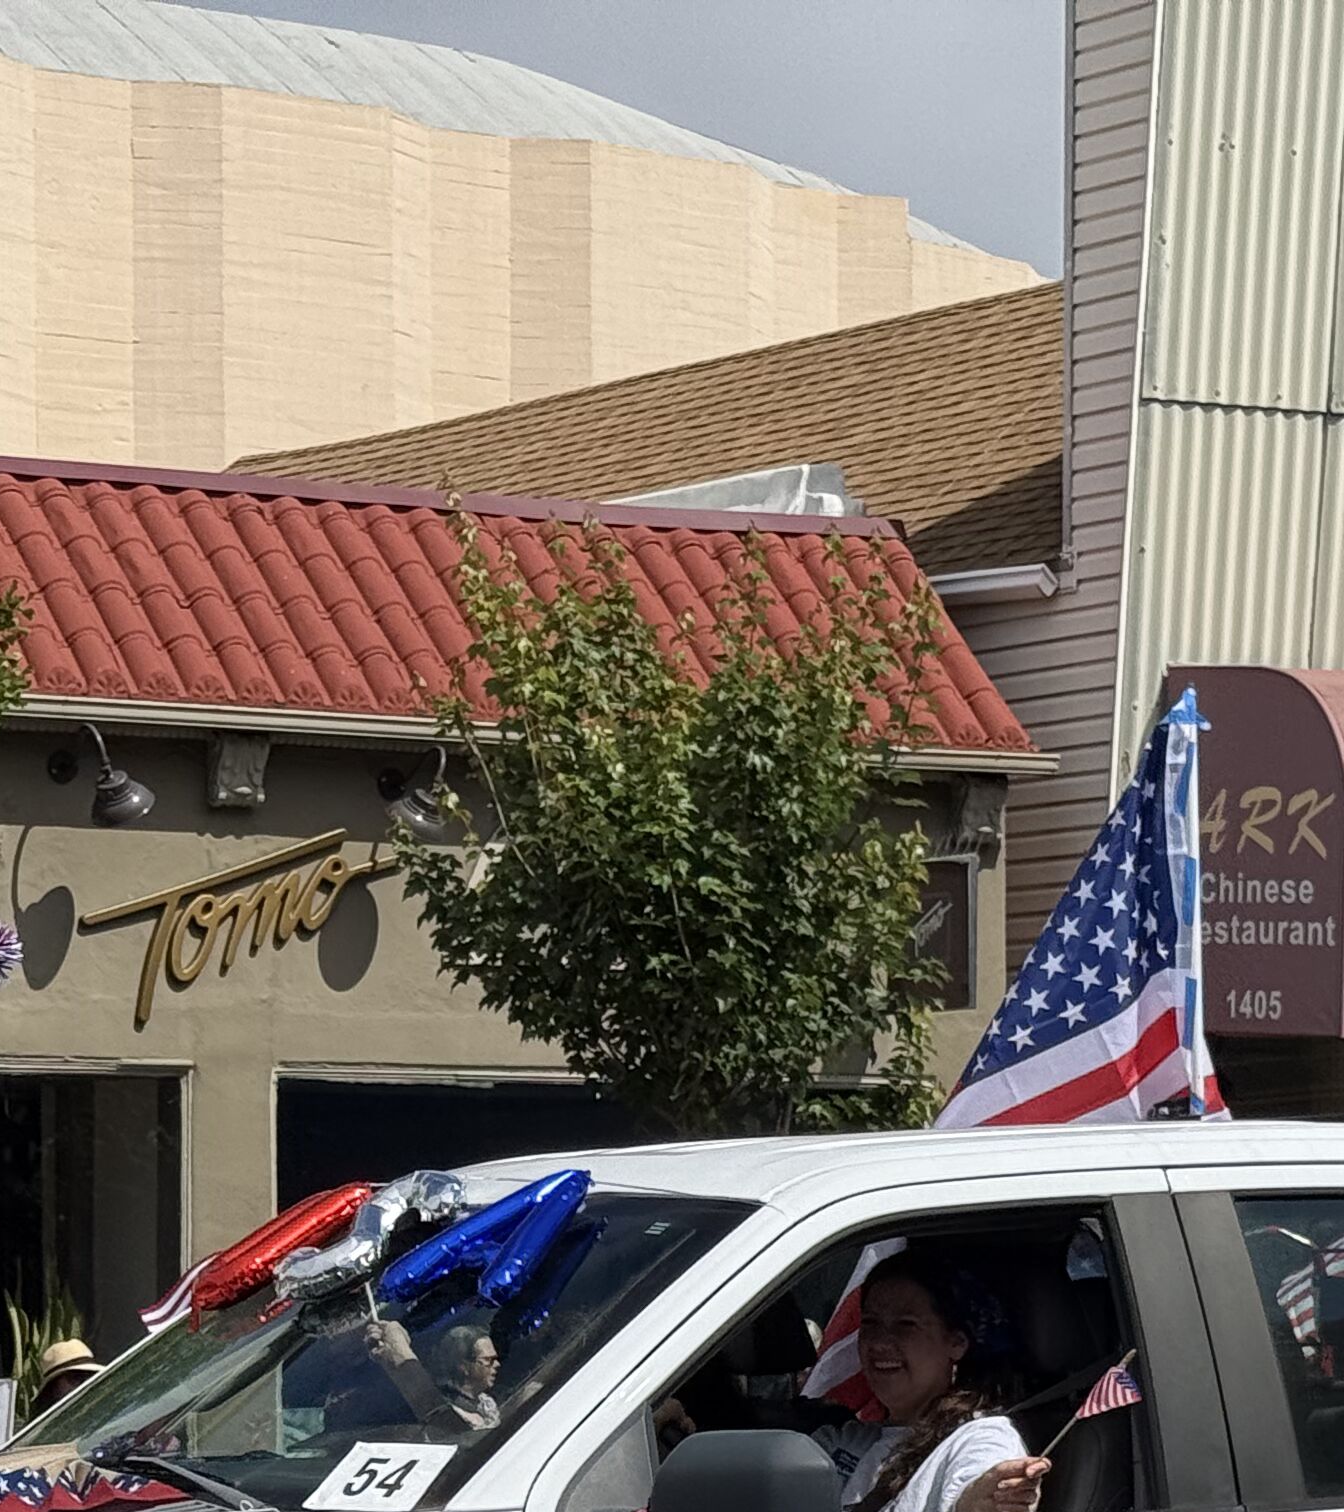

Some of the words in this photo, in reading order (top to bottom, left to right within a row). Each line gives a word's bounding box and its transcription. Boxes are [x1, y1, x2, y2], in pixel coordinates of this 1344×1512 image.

[1201, 786, 1337, 860] ARK
[1200, 871, 1315, 904] Chinese
[80, 828, 400, 1022] Tomo
[1200, 915, 1337, 947] estaurant
[1226, 989, 1283, 1020] 1405
[342, 1457, 420, 1498] 54
